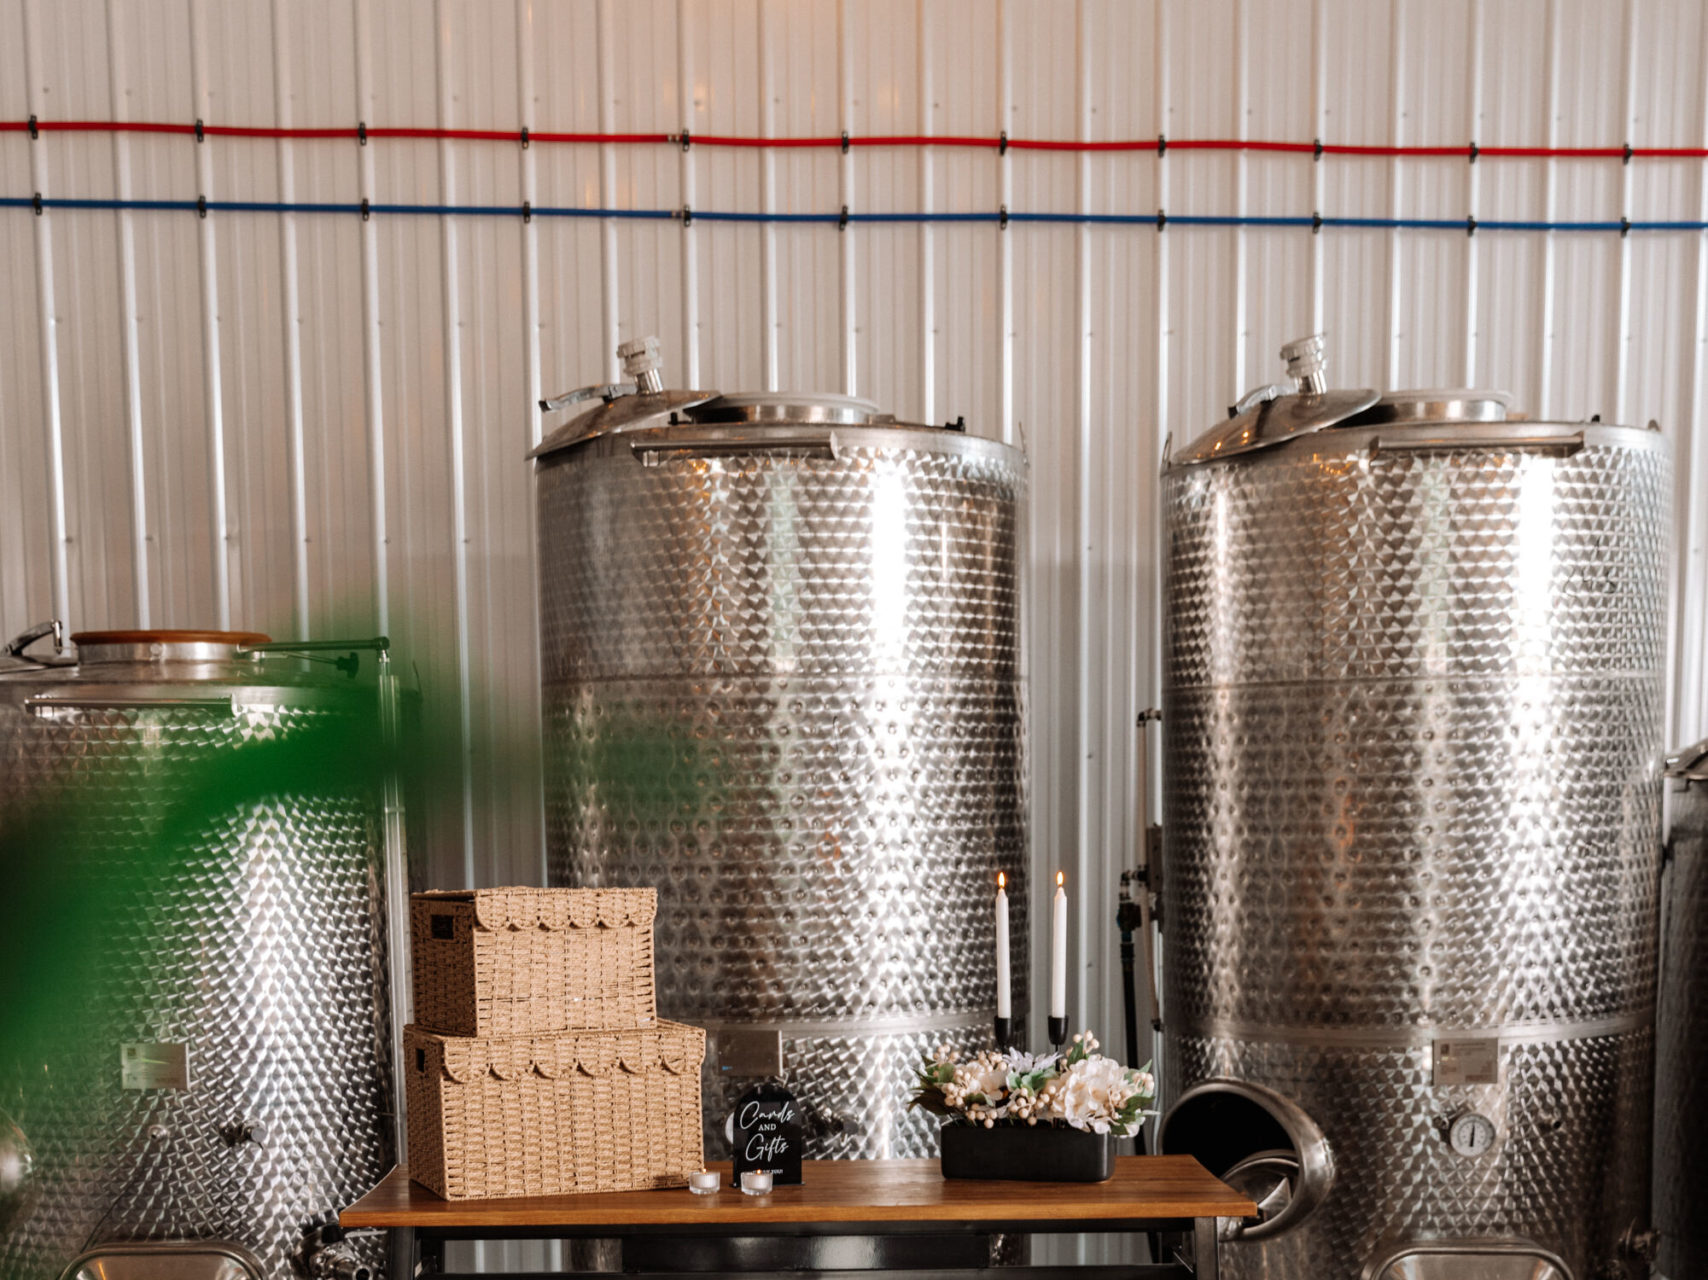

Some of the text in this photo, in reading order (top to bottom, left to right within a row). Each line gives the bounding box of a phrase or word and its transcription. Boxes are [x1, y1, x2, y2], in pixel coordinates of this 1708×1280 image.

[740, 1101, 795, 1130] Cards
[758, 1123, 777, 1131] AND
[745, 1133, 789, 1162] Gifts
